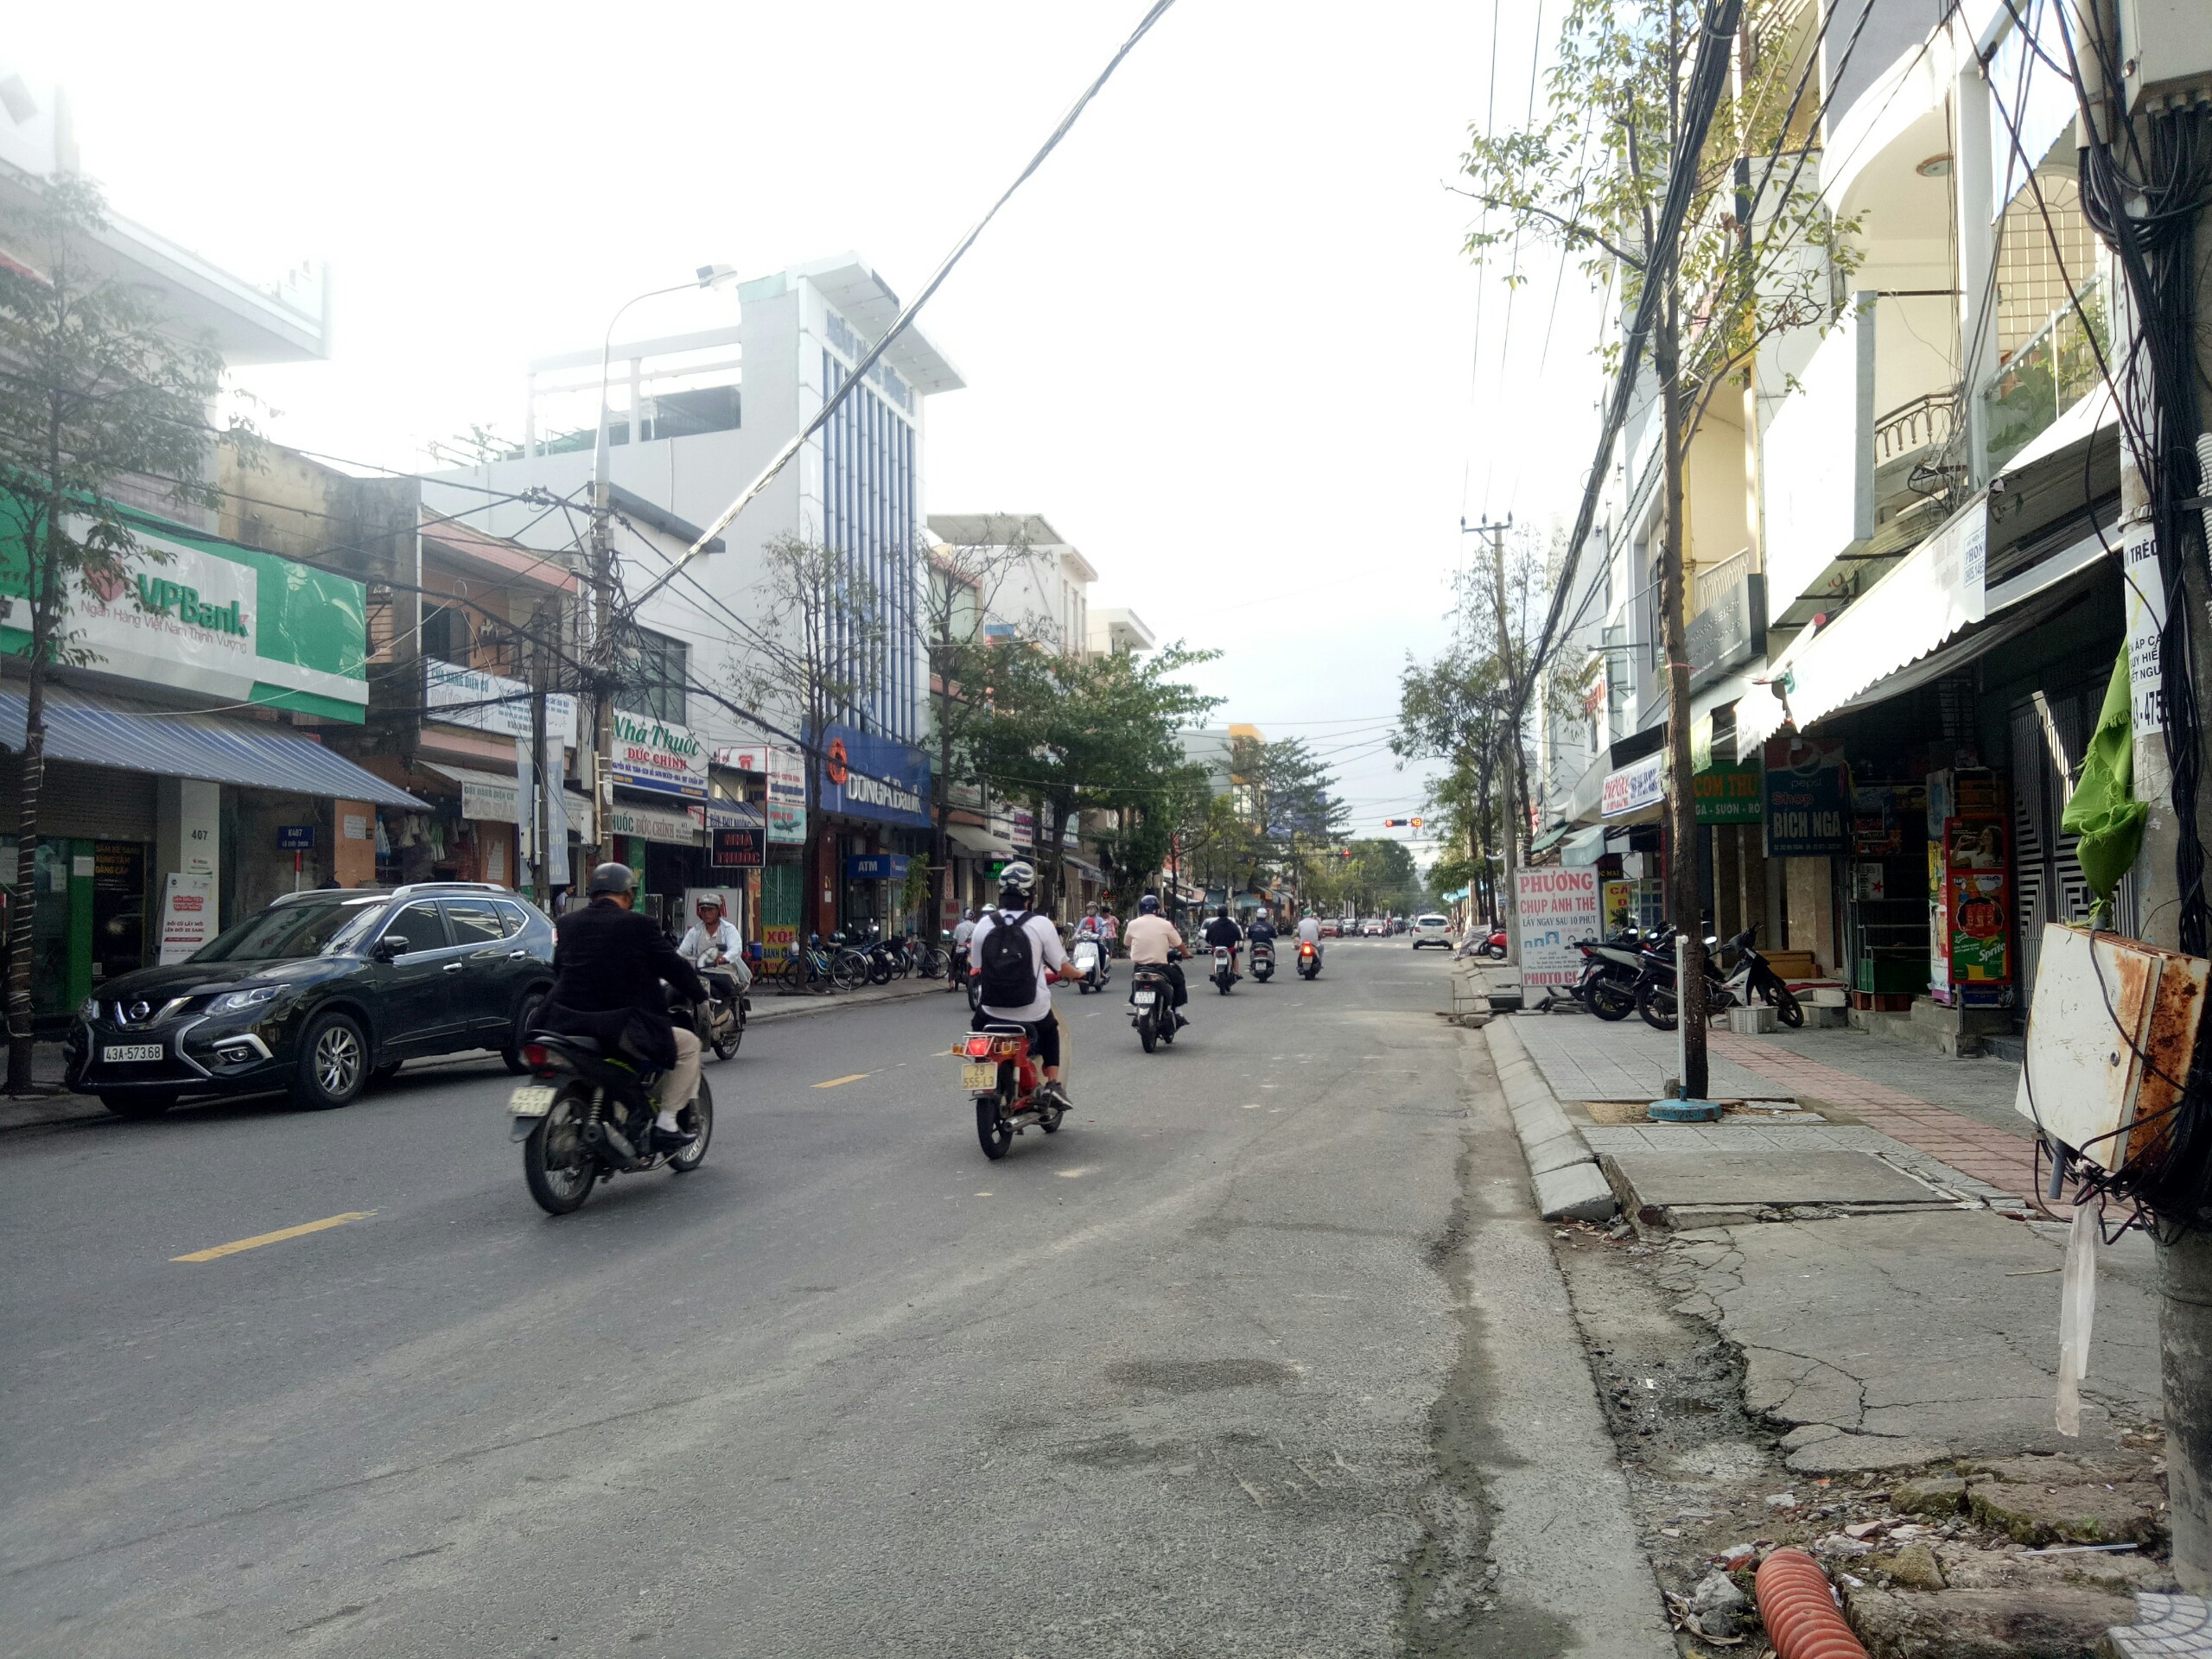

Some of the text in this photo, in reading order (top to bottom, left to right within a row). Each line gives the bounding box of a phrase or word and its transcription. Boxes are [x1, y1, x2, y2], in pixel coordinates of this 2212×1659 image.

[1965, 542, 1986, 566] PHON
[137, 573, 249, 637] VPBank
[80, 600, 247, 653] Ngân Hàng Việt Nam Thịnh Vượng
[627, 747, 650, 762] ĐỨC
[652, 753, 687, 771] CHÍNH
[1791, 778, 1821, 790] pepsi
[1772, 791, 1815, 807] Shop
[613, 811, 633, 832] HUỐC
[635, 815, 652, 835] ĐỨC
[652, 818, 675, 840] CHÍNH
[1773, 808, 1841, 838] BÍCH NGA
[191, 830, 208, 841] 407
[858, 861, 878, 872] ATM
[1520, 870, 1594, 893] PHƯƠNG
[1521, 891, 1597, 917] CHỤP ẢNH THẺ
[1522, 913, 1597, 927] LẤY NGAY SAU 10 PHÚT
[1979, 941, 2005, 963] Sprite
[1524, 970, 1562, 985] PHOTO
[105, 1046, 161, 1060] 43A-573.68
[974, 1065, 985, 1077] 29
